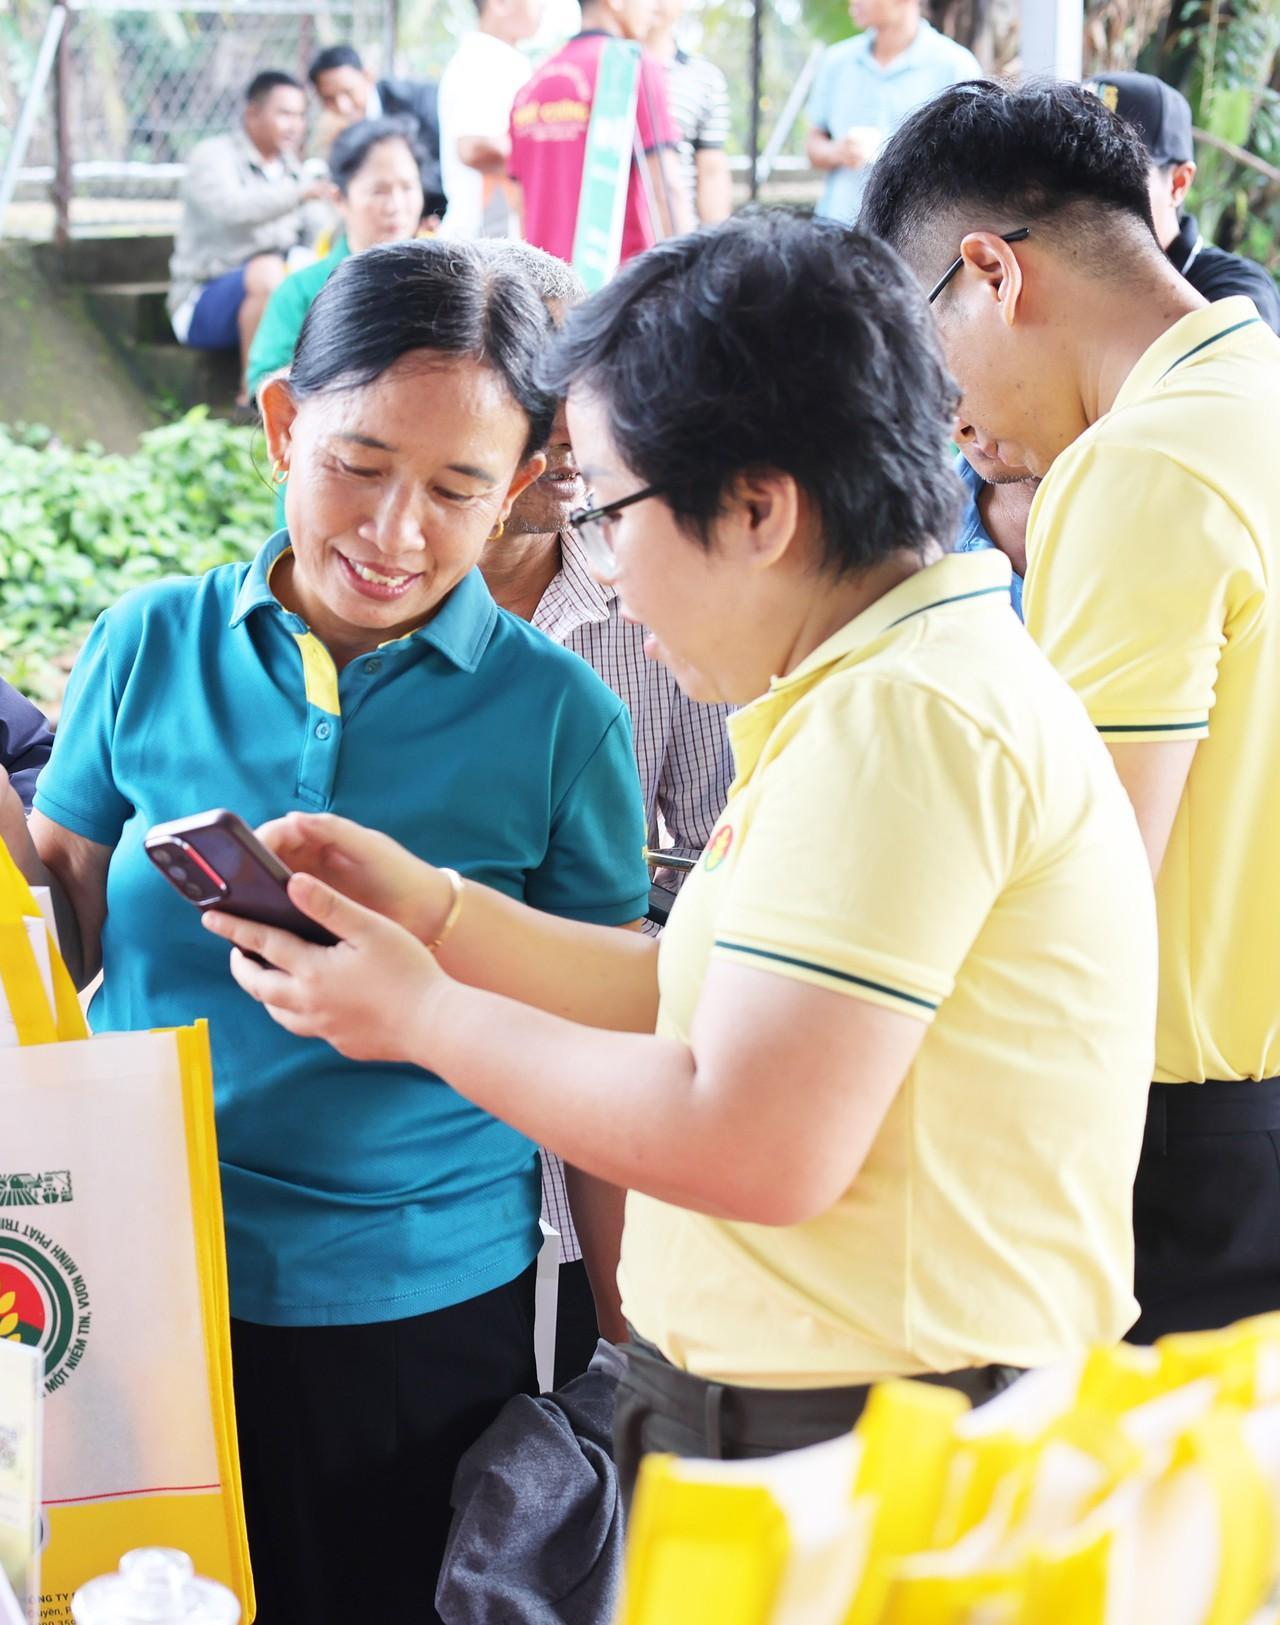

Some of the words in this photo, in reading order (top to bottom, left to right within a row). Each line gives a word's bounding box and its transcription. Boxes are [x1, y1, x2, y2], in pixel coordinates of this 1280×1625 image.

[22, 1224, 53, 1250] PHÁT
[77, 1312, 93, 1336] TIN,
[45, 1369, 70, 1394] MỘT
